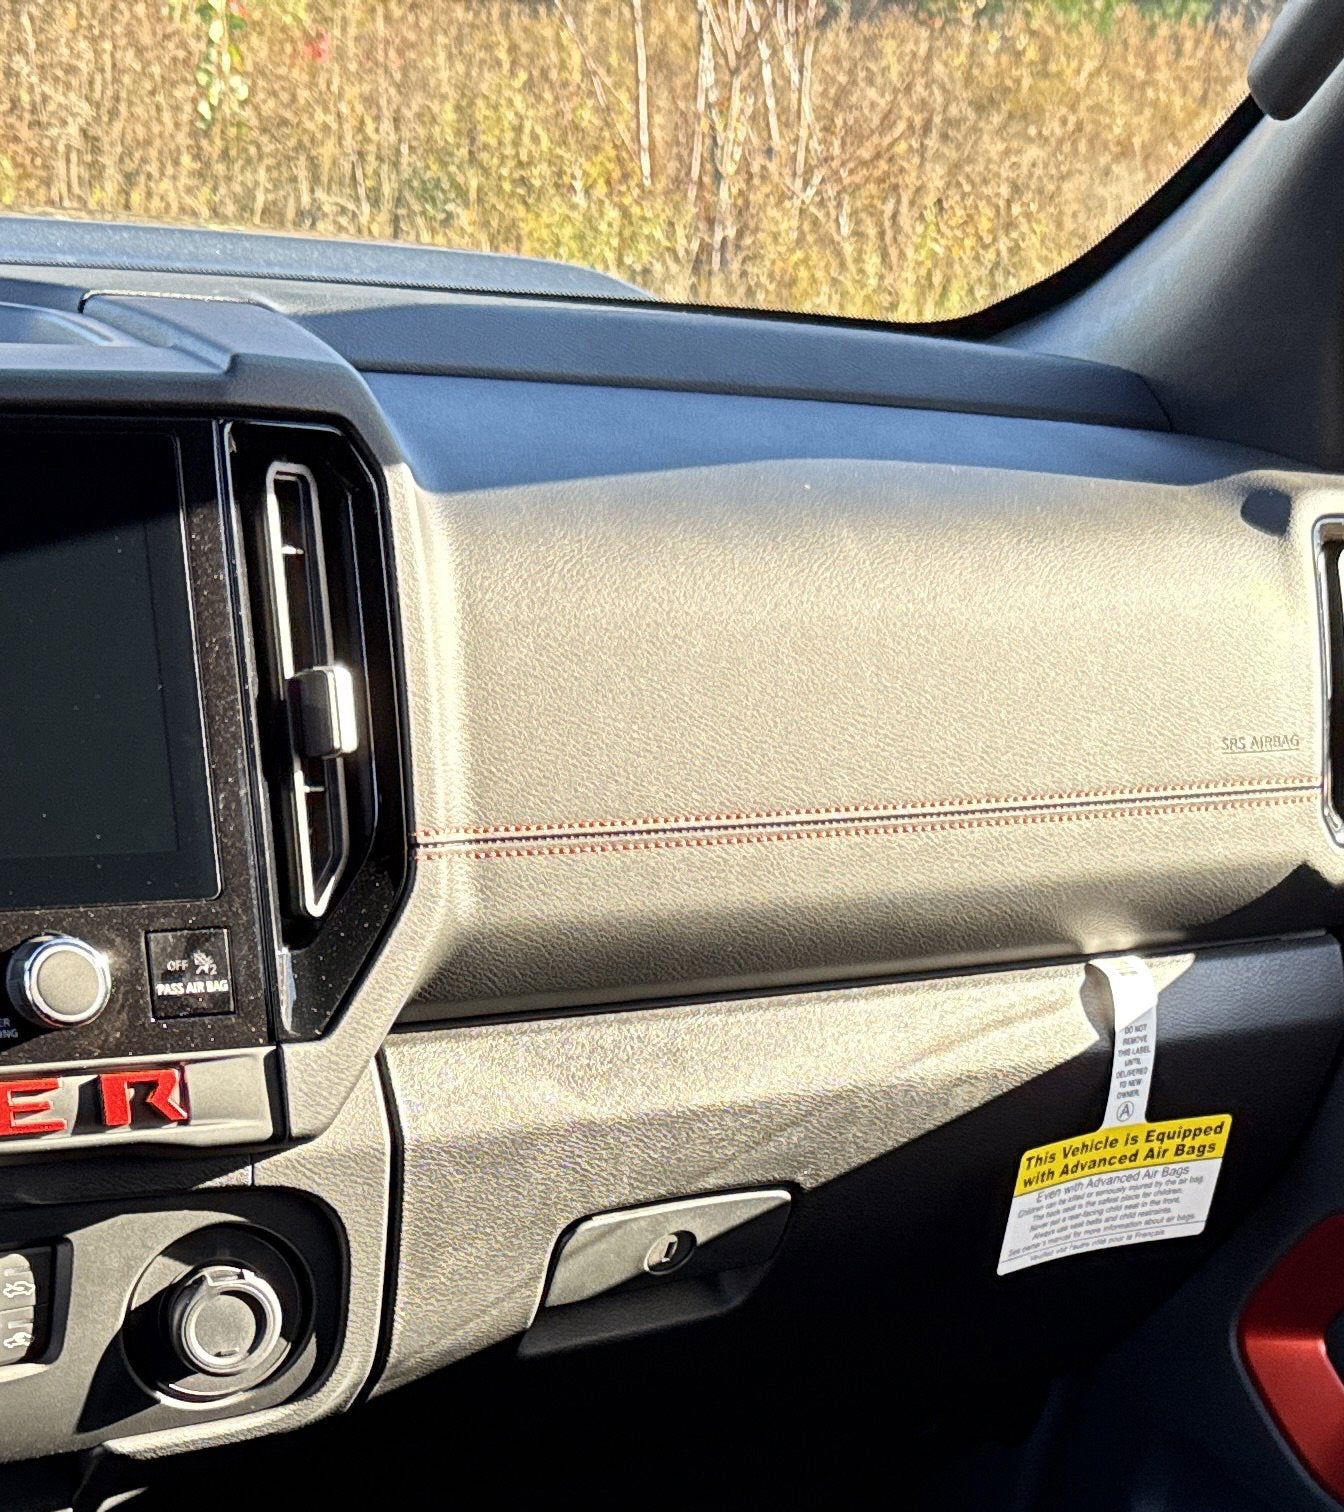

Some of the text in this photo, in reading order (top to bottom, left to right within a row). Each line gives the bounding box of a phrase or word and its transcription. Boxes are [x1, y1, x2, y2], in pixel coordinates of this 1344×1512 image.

[1221, 734, 1300, 751] SRS AIRBAG
[166, 958, 189, 972] OFF
[156, 979, 229, 996] PASS AIR BAG
[1124, 1027, 1134, 1036] DO
[1132, 1045, 1151, 1056] LABEL
[1128, 1078, 1143, 1088] NEW
[1026, 1121, 1225, 1170] This Vehicle is Equipped
[1023, 1141, 1217, 1188] with Advanced Air Bags
[1036, 1164, 1190, 1203] Even with Advanced Air Bags
